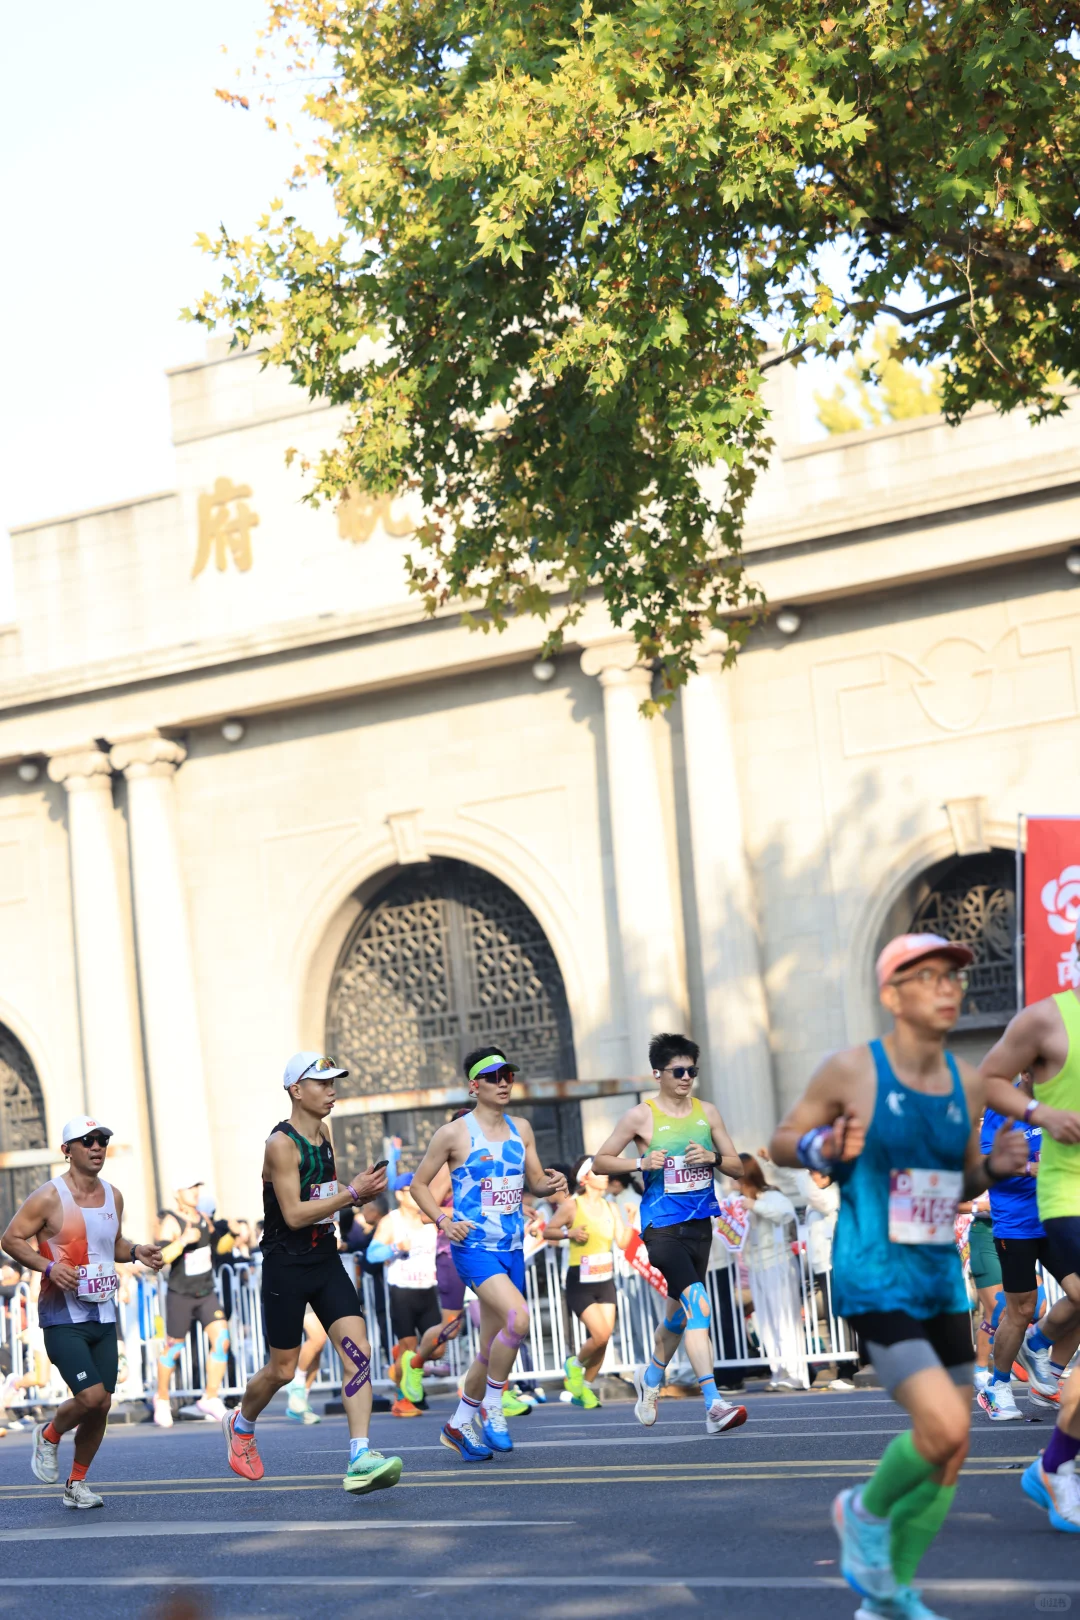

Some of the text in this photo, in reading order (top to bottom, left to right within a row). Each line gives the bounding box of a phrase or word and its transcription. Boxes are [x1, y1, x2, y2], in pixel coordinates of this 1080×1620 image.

[191, 476, 260, 579] 府
[667, 1159, 674, 1168] D
[677, 1167, 710, 1183] 10555
[484, 1180, 492, 1189] D
[312, 1187, 320, 1196] A
[493, 1190, 522, 1206] 29005
[79, 1268, 87, 1277] D
[89, 1276, 117, 1293] 13442
